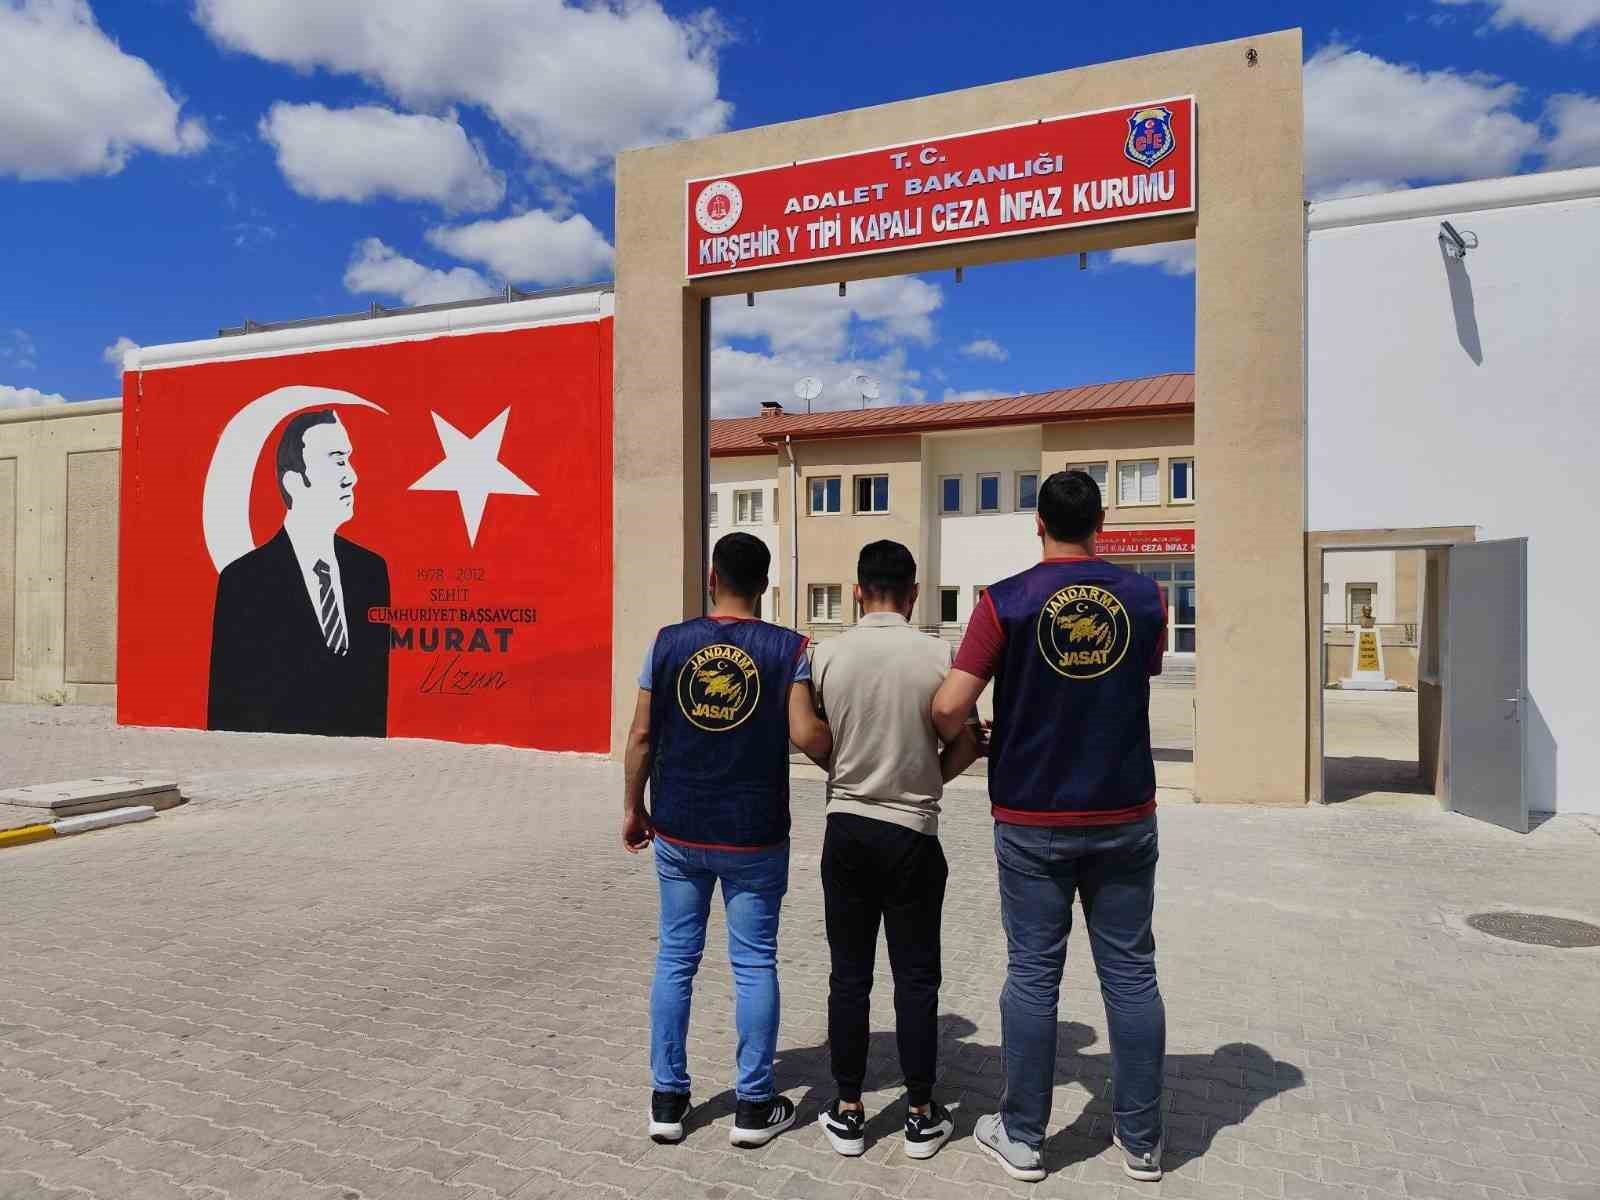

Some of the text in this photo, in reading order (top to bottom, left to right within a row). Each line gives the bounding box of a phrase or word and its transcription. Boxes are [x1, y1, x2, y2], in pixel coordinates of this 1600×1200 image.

[890, 147, 946, 170] T. C.
[784, 152, 1064, 215] ADALET BAKANLIĞI
[699, 169, 1176, 267] KIRŞEHİR Y TİPİ KAPALI CEZA İNFAZ KURUMU
[1141, 544, 1163, 553] CEZA
[456, 567, 486, 581] 2012
[1045, 587, 1121, 619] JANDARMA
[390, 626, 515, 653] MURAT
[690, 646, 756, 680] JANDARMA
[1059, 649, 1110, 667] JASAT
[418, 653, 508, 696] Uzun
[691, 703, 738, 721] JASAT
